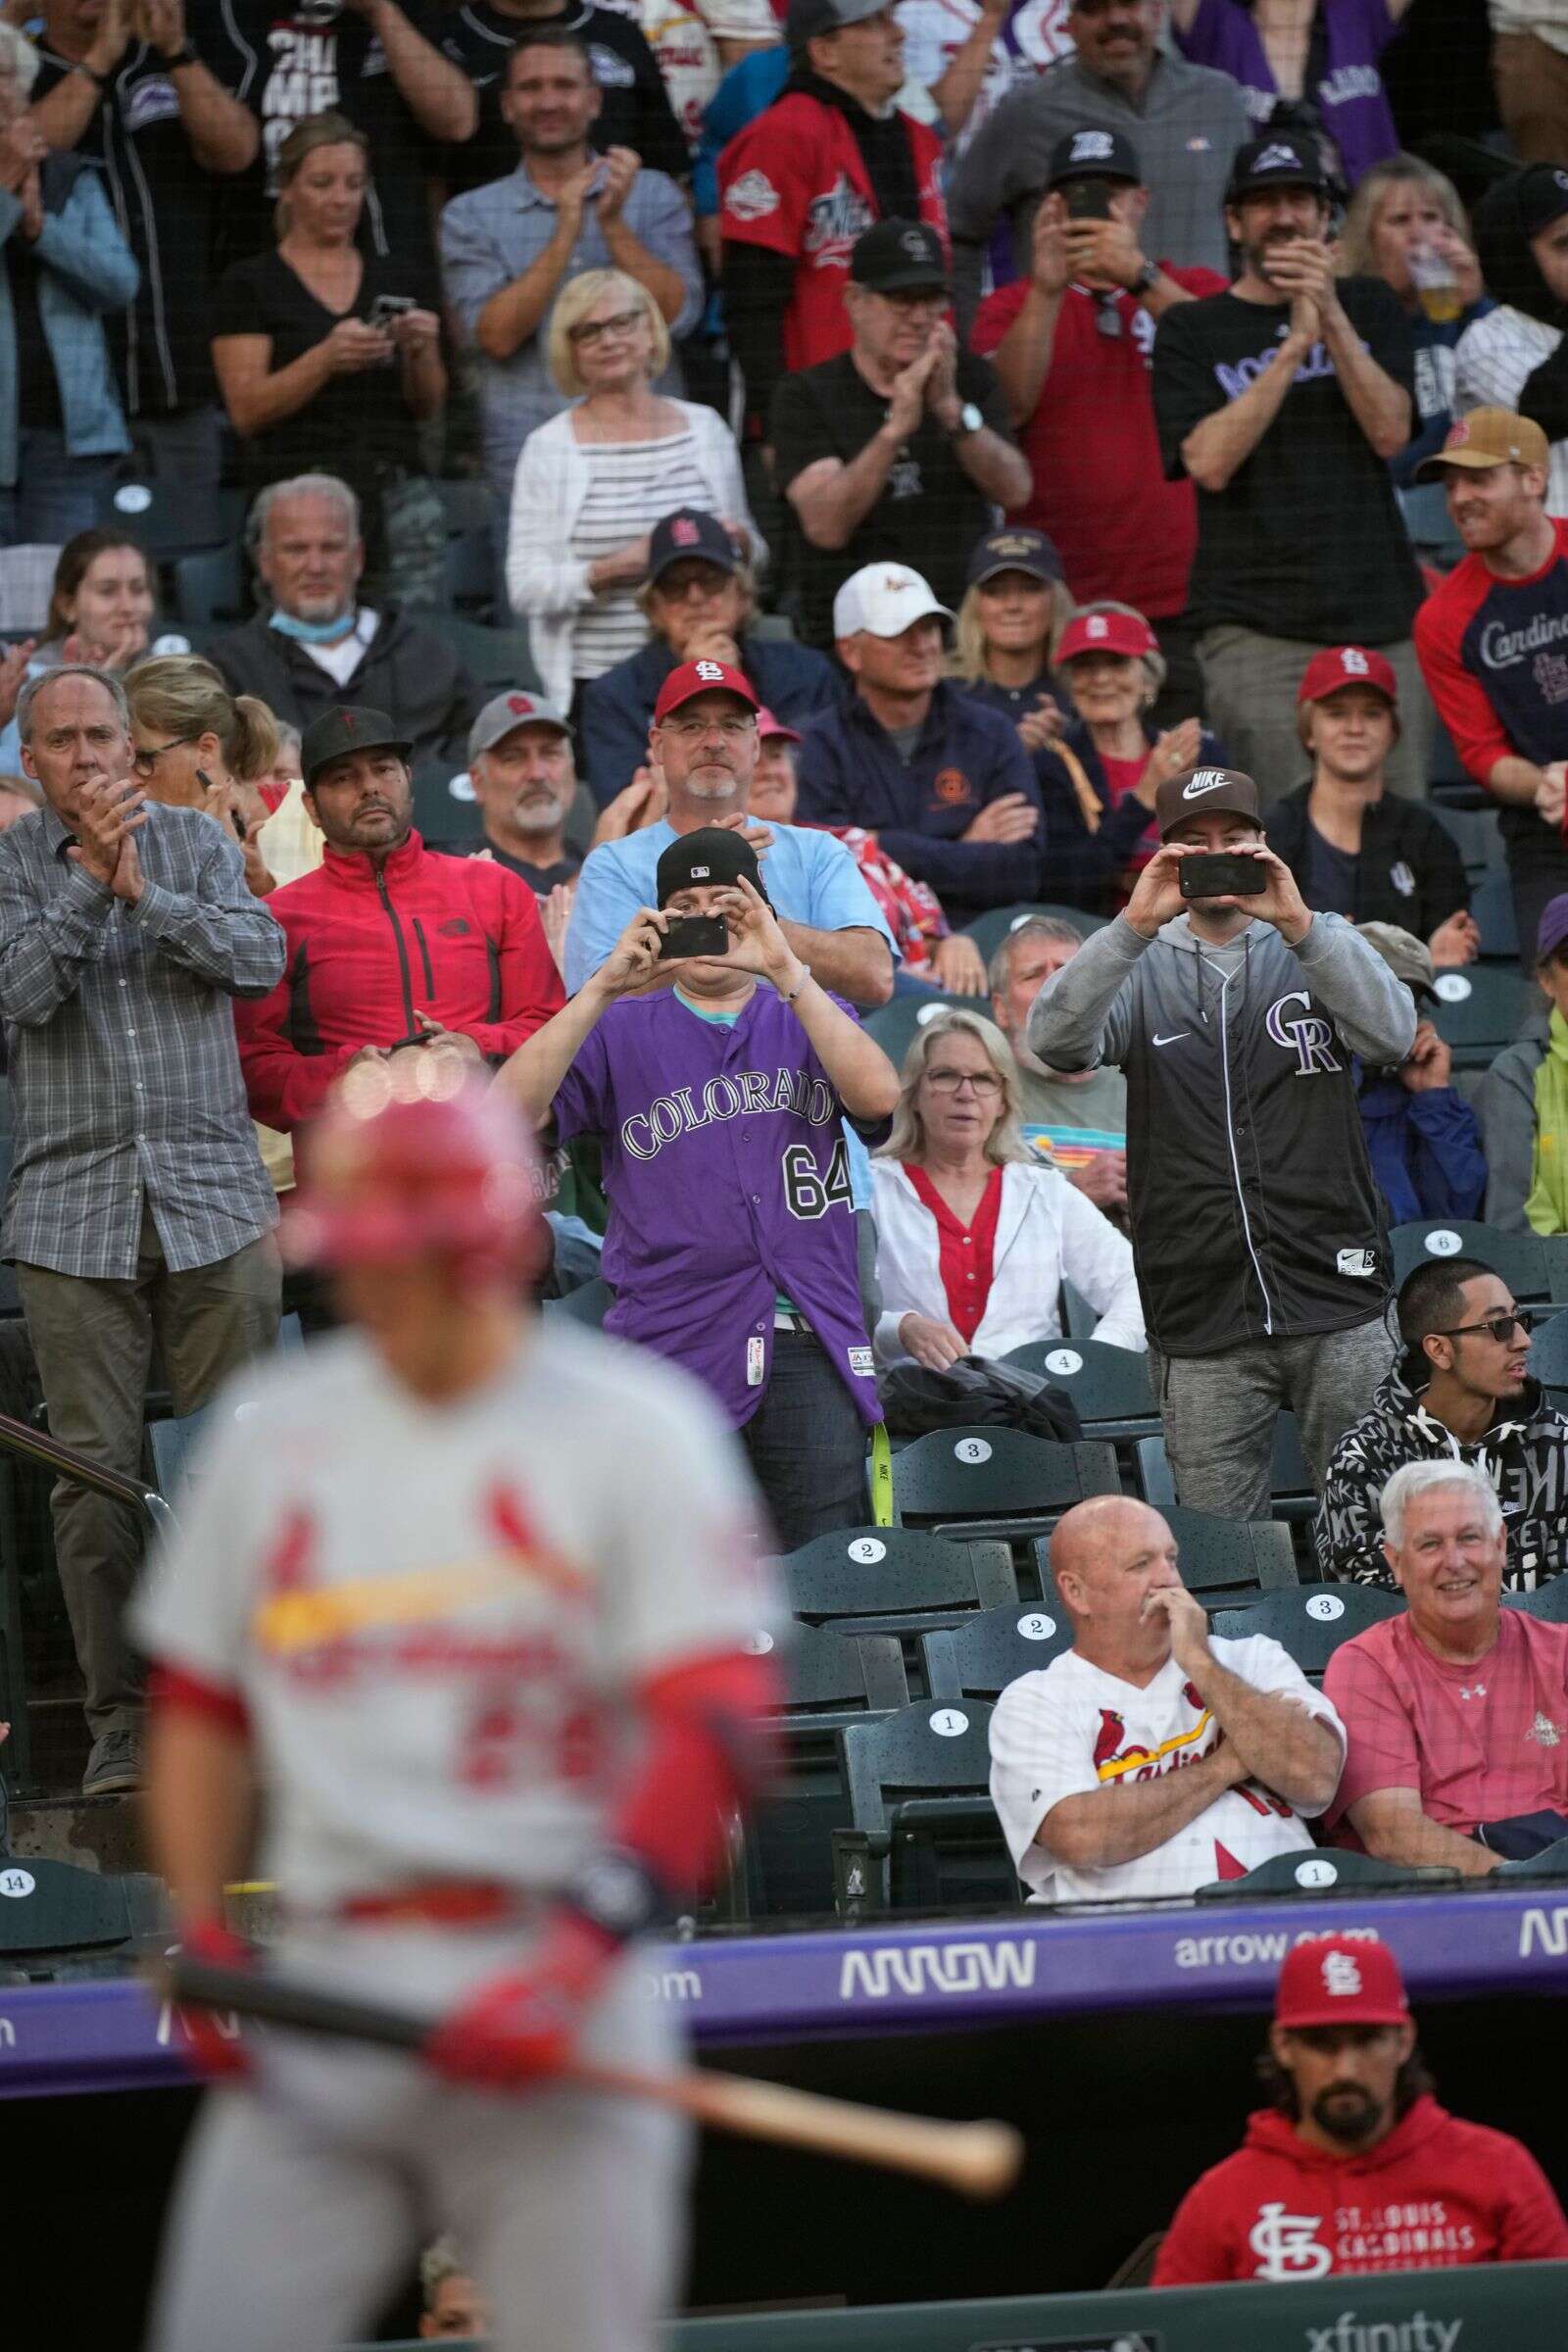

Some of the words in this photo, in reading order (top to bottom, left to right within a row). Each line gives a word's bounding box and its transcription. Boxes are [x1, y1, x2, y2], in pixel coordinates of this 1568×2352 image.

[1190, 770, 1226, 791] NIKE
[621, 1066, 835, 1160] COLORADO
[782, 1136, 856, 1221] 64
[1058, 1355, 1072, 1369] 4
[967, 1443, 981, 1458] 3
[880, 1463, 889, 1482] NIKE
[861, 1544, 874, 1558] 2
[1319, 1600, 1333, 1615] 3
[1030, 1619, 1045, 1634] 2
[945, 1716, 956, 1730] 1
[5, 1875, 26, 1890] 14
